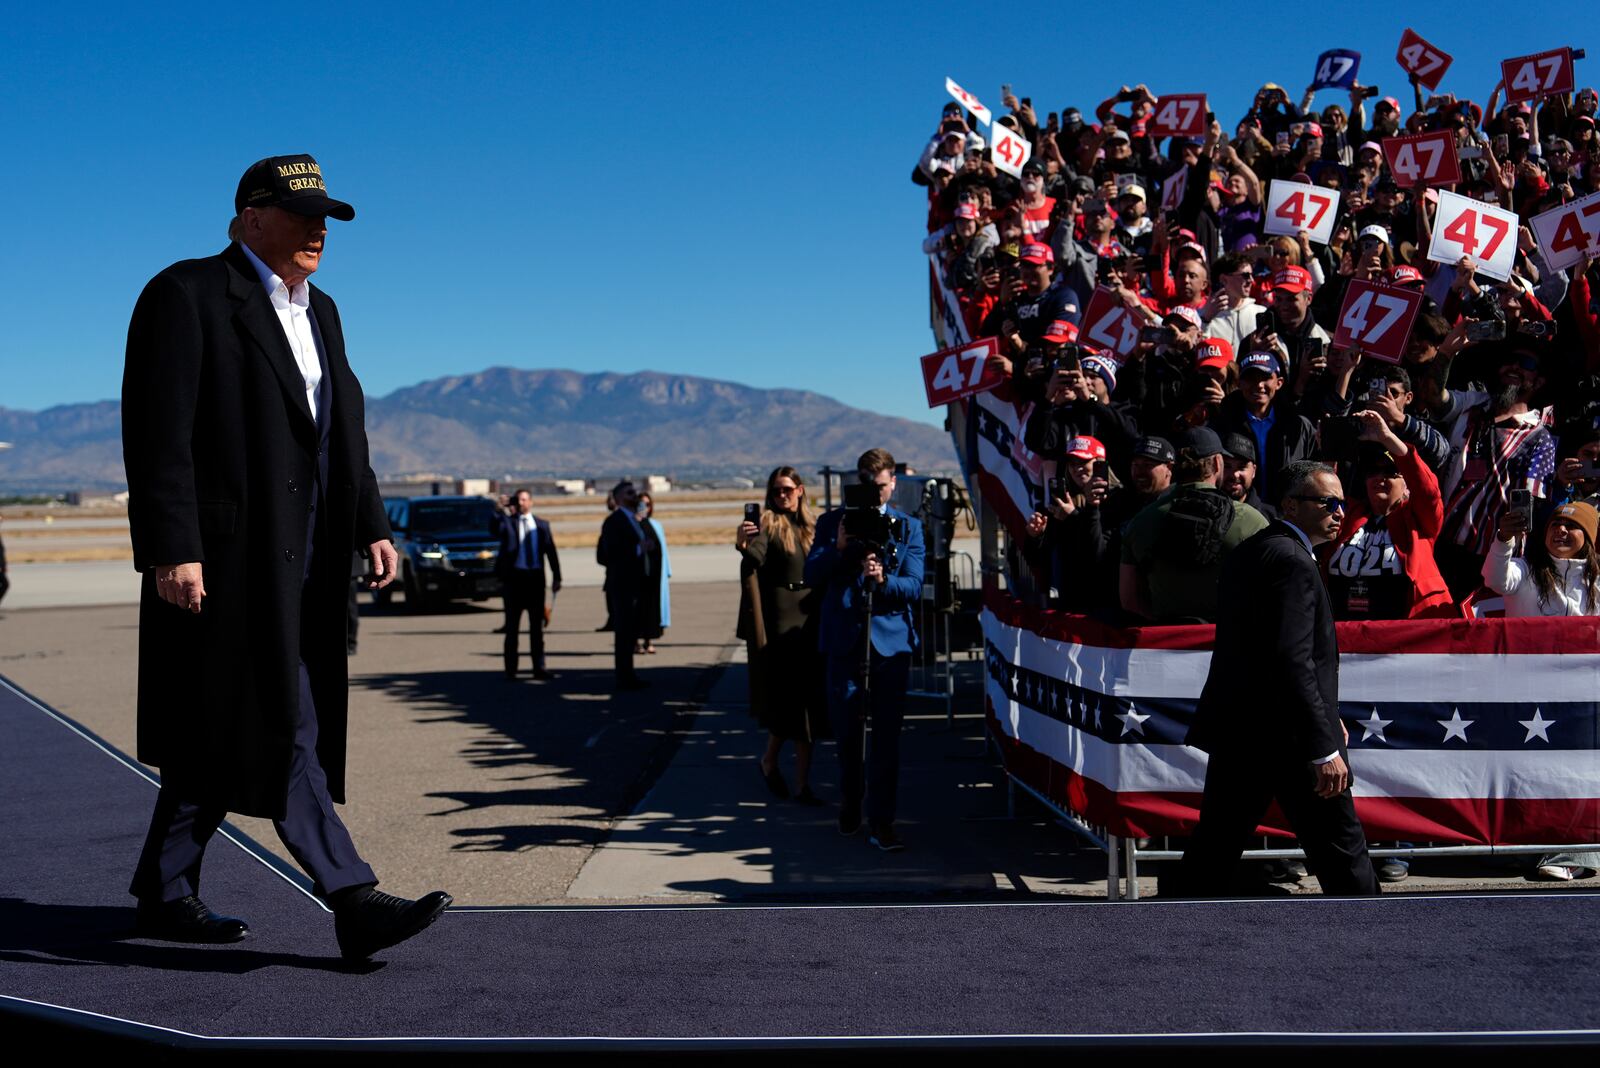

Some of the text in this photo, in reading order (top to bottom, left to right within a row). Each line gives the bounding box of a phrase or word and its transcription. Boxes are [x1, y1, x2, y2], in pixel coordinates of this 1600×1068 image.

[1316, 56, 1354, 83] 47
[1402, 42, 1444, 77] 47
[1511, 54, 1563, 93] 47
[1155, 99, 1200, 131] 47
[277, 162, 308, 177] MAKE
[996, 136, 1025, 168] 47
[1394, 138, 1445, 181] 47
[289, 177, 318, 191] GREAT
[1275, 191, 1331, 230] 47
[1444, 208, 1509, 261] 47
[1088, 306, 1139, 356] 47
[1342, 290, 1410, 344] 47
[932, 345, 990, 392] 47
[1328, 543, 1402, 577] 2024
